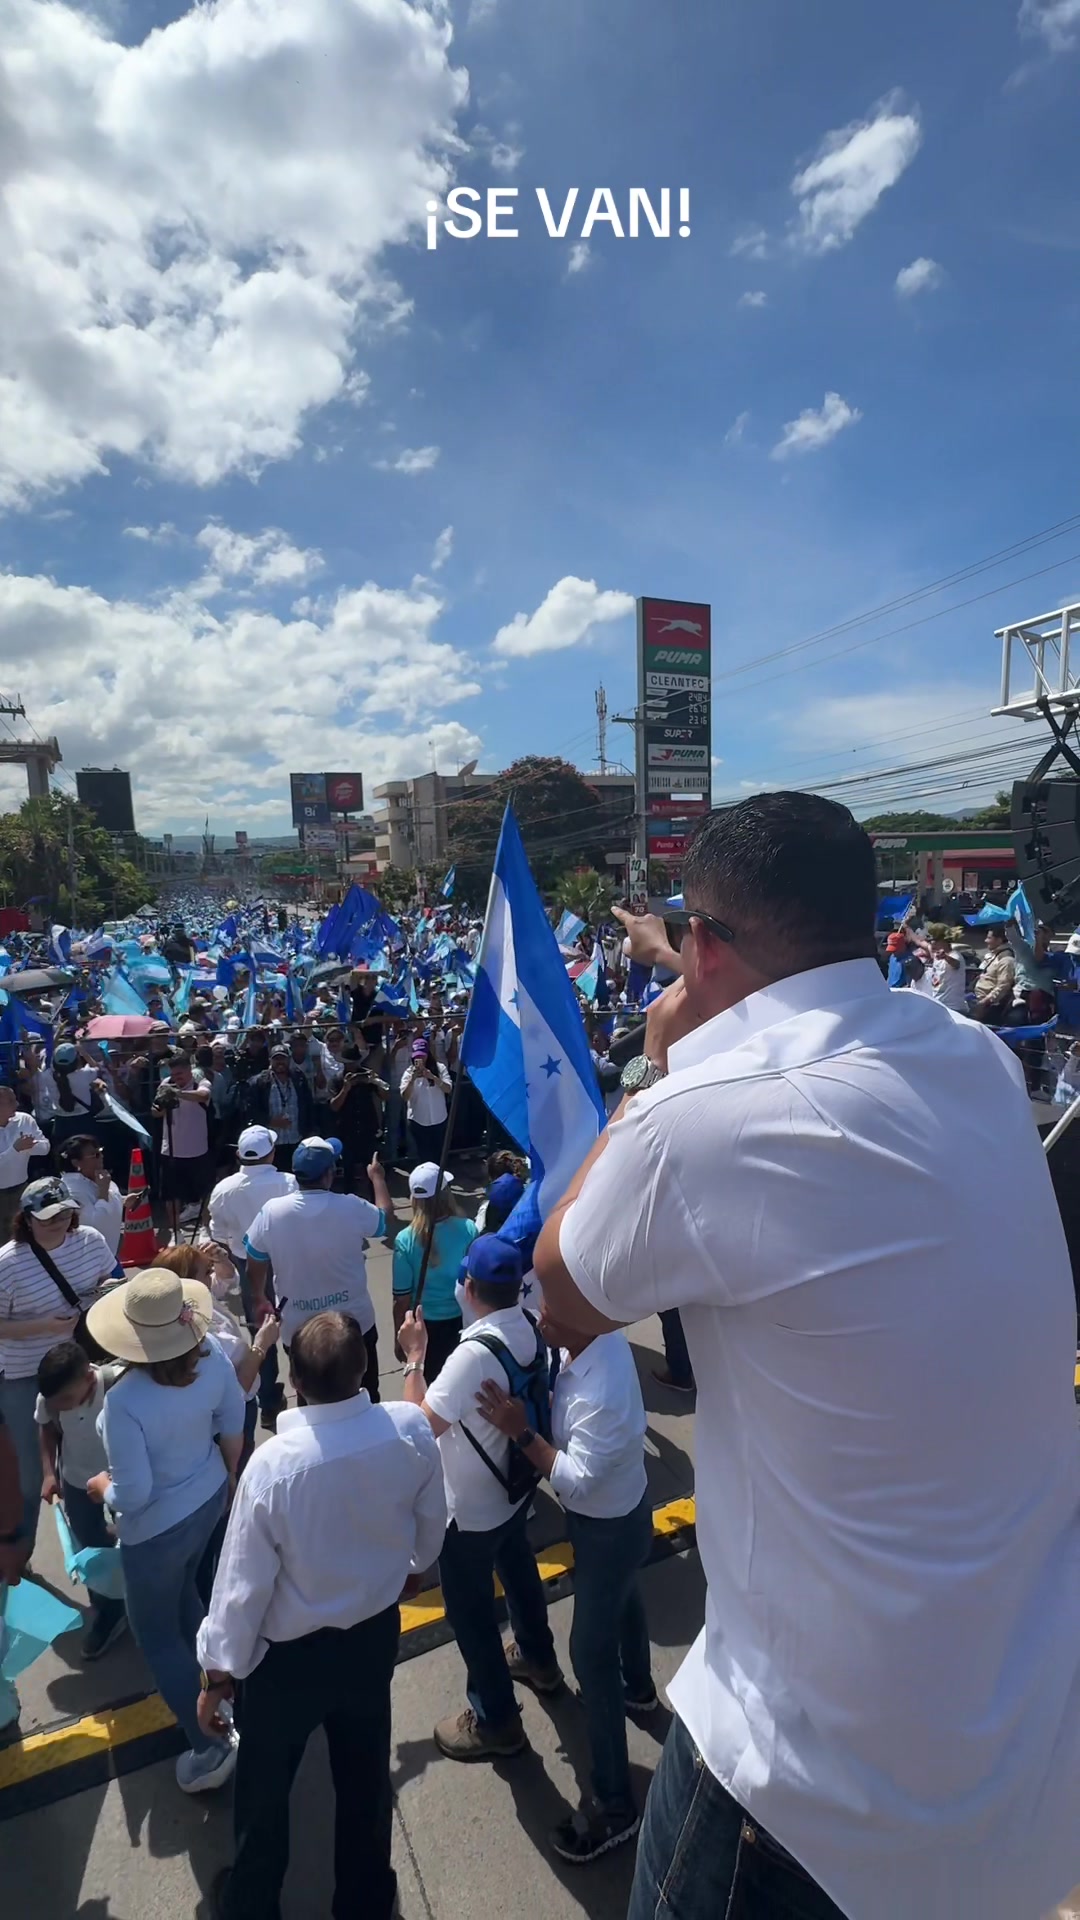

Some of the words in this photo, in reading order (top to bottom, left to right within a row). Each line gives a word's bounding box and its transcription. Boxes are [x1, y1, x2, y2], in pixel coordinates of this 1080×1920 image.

[654, 650, 702, 665] PUMA
[650, 675, 705, 689] CLEANTEC
[672, 750, 705, 758] PUMA
[872, 838, 907, 849] PUMA
[293, 1290, 349, 1311] HONDURAS
